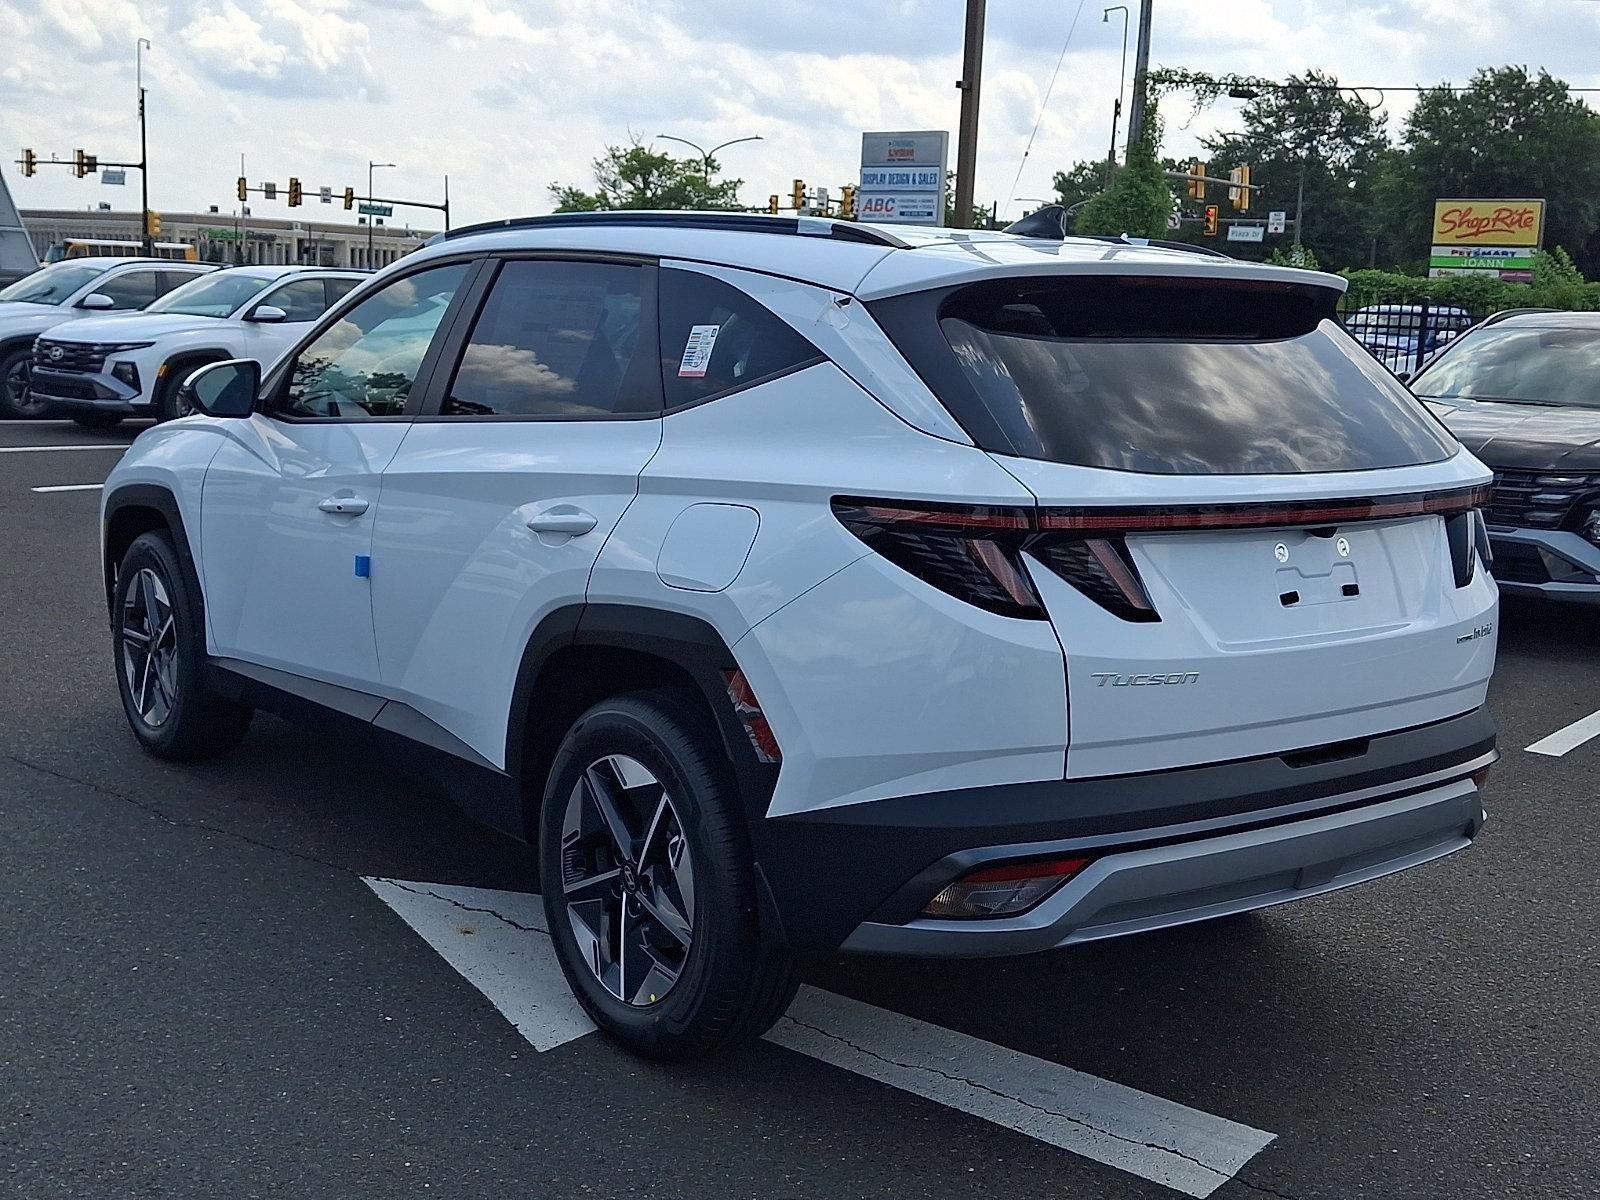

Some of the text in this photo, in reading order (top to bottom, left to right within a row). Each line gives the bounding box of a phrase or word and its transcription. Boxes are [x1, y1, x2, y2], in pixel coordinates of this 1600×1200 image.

[863, 172, 937, 185] DISPLAY DESIGN & SALES
[862, 197, 896, 212] ABC
[1438, 207, 1534, 238] ShopRite
[1461, 259, 1504, 268] JOANN
